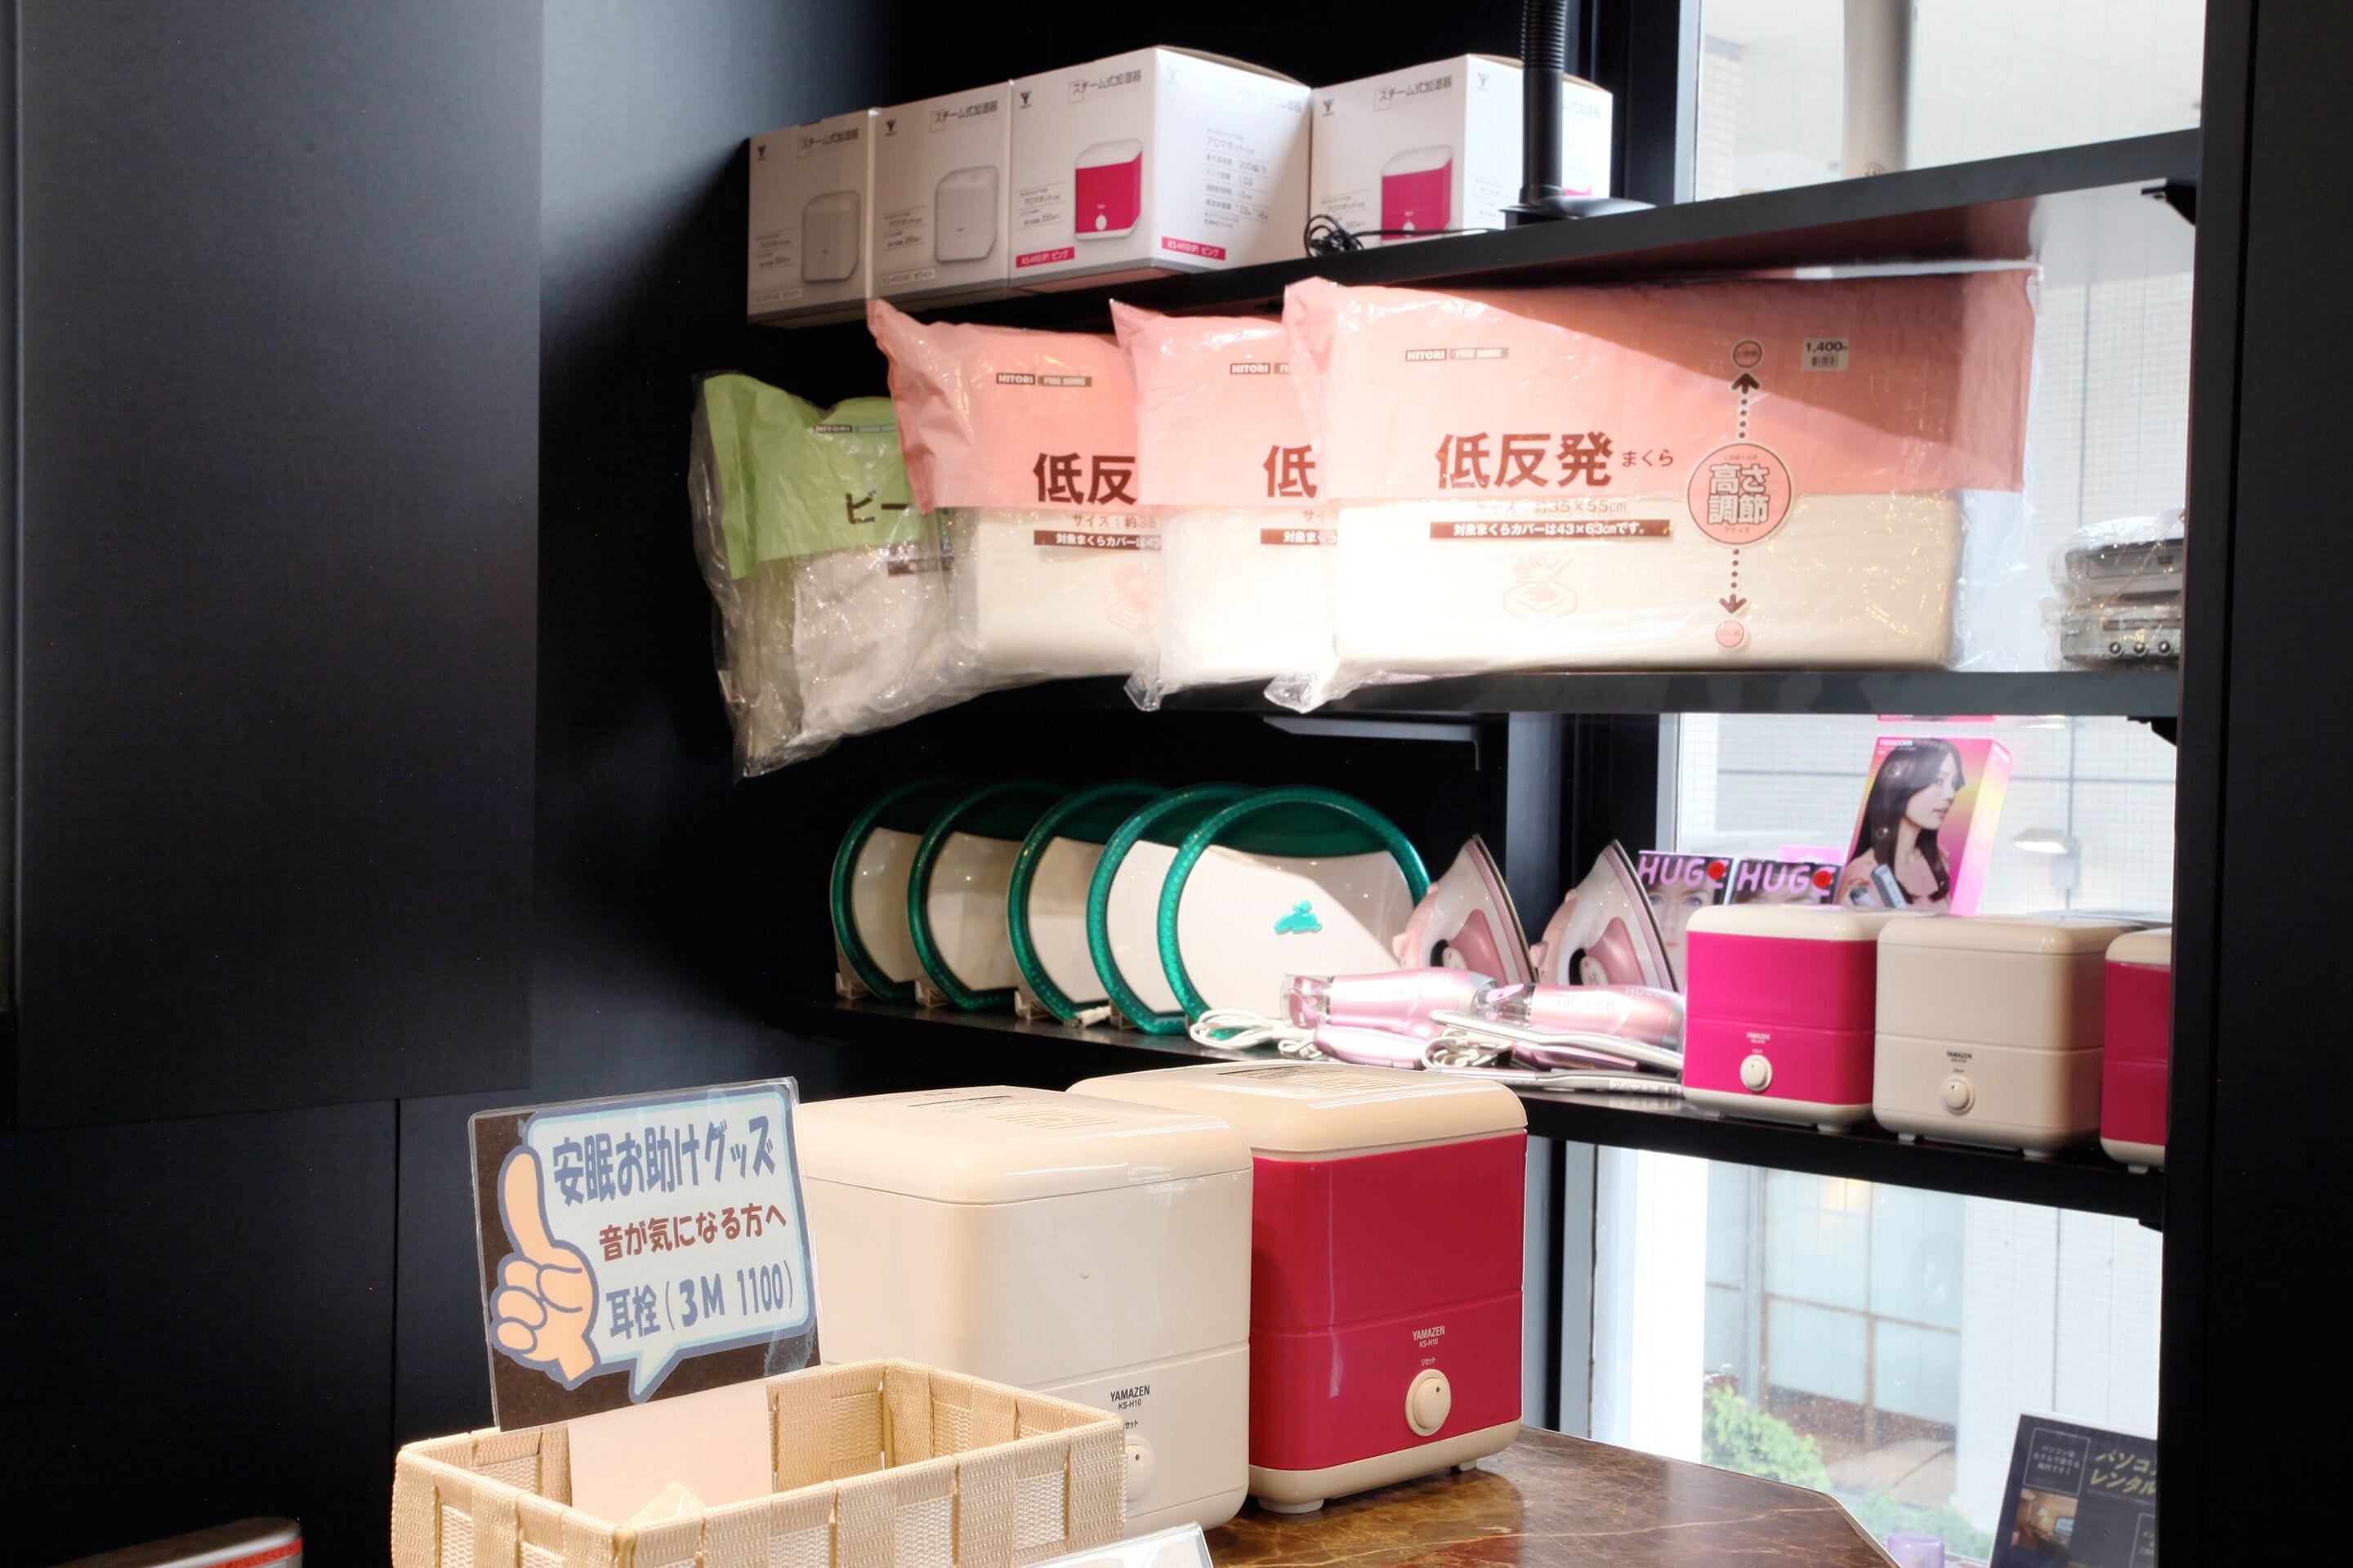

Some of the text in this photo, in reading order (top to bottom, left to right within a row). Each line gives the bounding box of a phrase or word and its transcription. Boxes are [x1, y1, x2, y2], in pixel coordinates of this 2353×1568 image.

[1406, 350, 1445, 360] NITORI
[1476, 349, 1502, 358] HOME
[998, 373, 1086, 386] NITORI FINE HOME
[1231, 364, 1269, 374] NITORI
[1263, 444, 1318, 498] 低
[1435, 431, 1674, 490] 低反発 まくら
[1032, 452, 1137, 506] 低反
[1709, 462, 1770, 494] 高さ
[1707, 494, 1770, 525] 調節
[1946, 1051, 1972, 1060] YAMAZEN
[552, 1115, 775, 1207] 安眠お助けグッズ
[599, 1203, 788, 1262] 音が気になる方へ
[1412, 1325, 1445, 1341] YAMAZEN
[1418, 1338, 1439, 1348] KS-H10
[1110, 1385, 1150, 1402] YAMAZEN
[1118, 1399, 1142, 1409] KS-H10
[2090, 1469, 2157, 1495] レンタル
